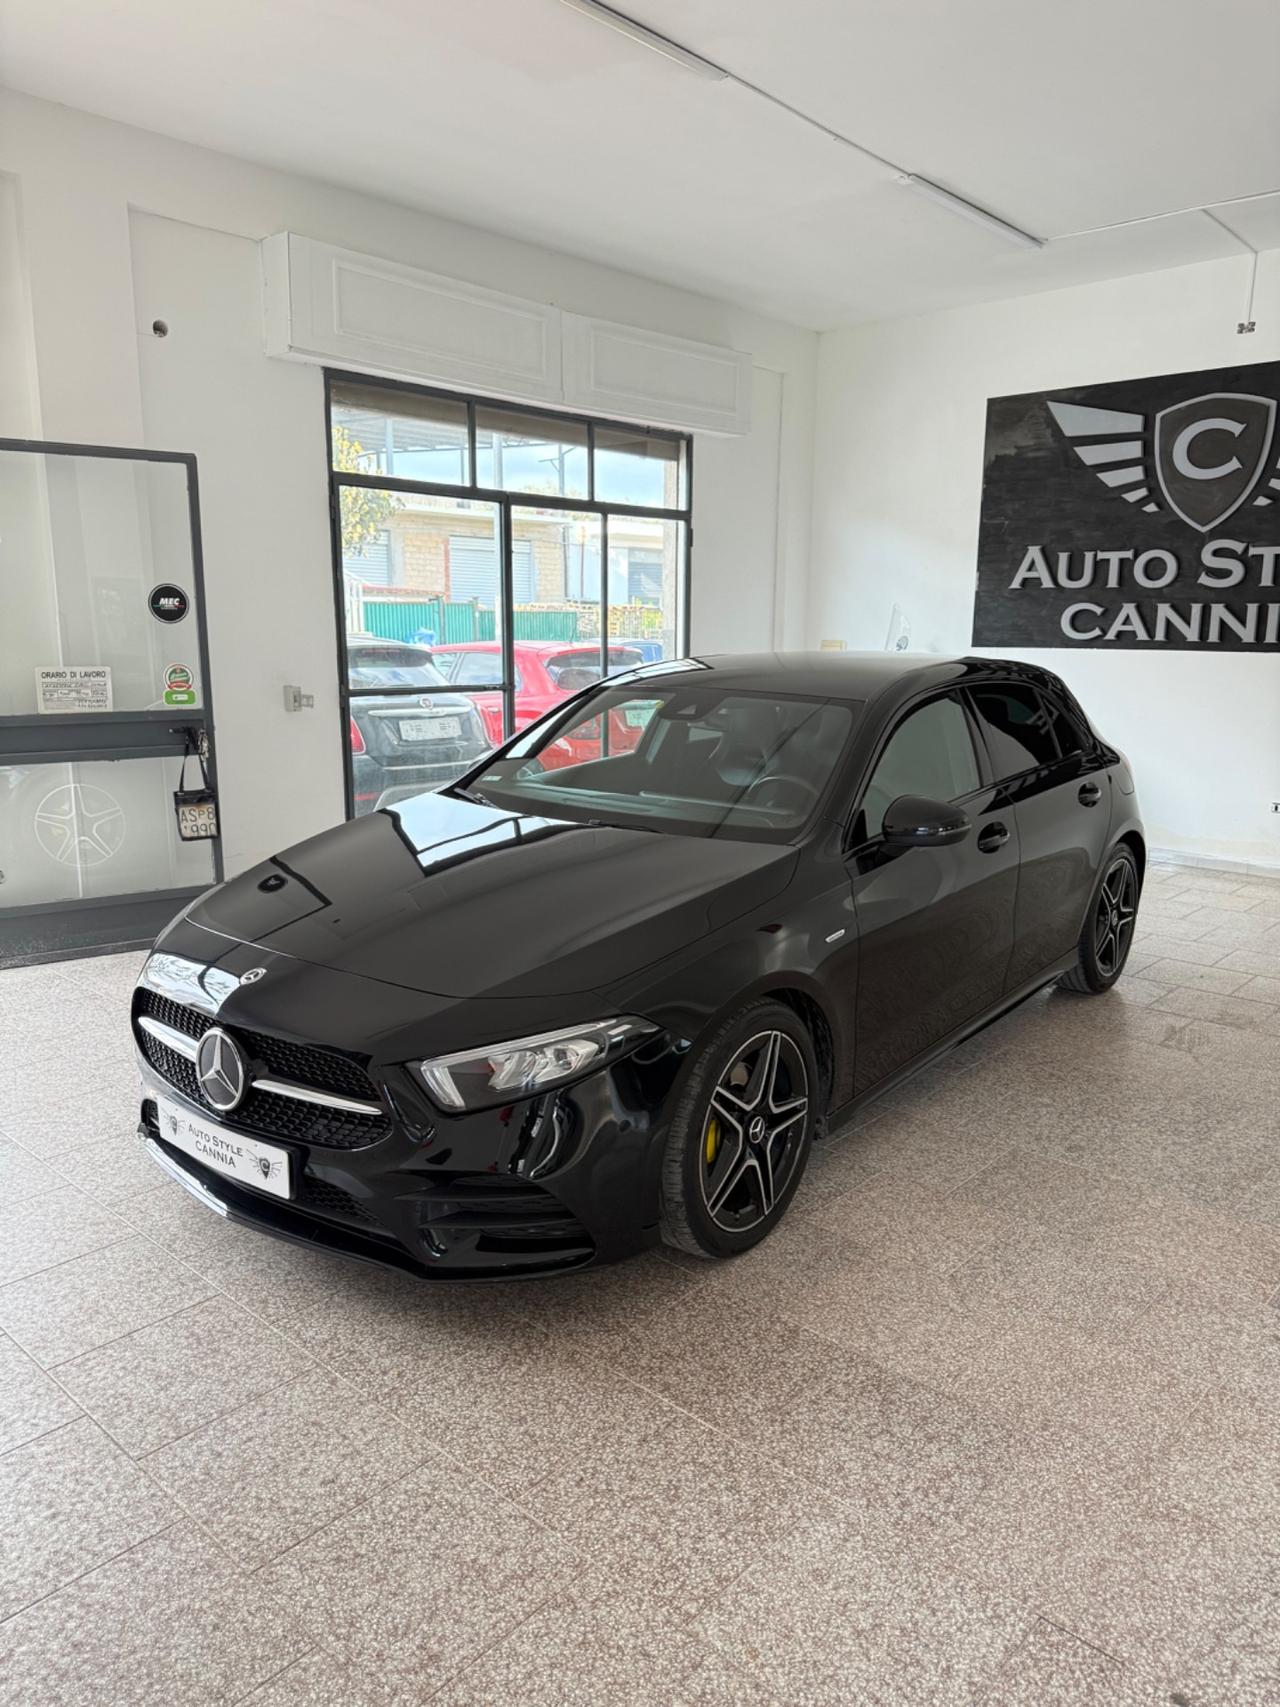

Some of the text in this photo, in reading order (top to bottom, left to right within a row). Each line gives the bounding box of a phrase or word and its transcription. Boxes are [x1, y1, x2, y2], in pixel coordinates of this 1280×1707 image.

[1172, 418, 1247, 480] C
[1008, 545, 1178, 590] AUTO
[159, 597, 180, 605] MEC
[41, 671, 67, 679] ORARIO
[188, 1123, 211, 1144] AUTO
[212, 1135, 244, 1158] STYLE
[195, 1140, 237, 1168] CANNIA
